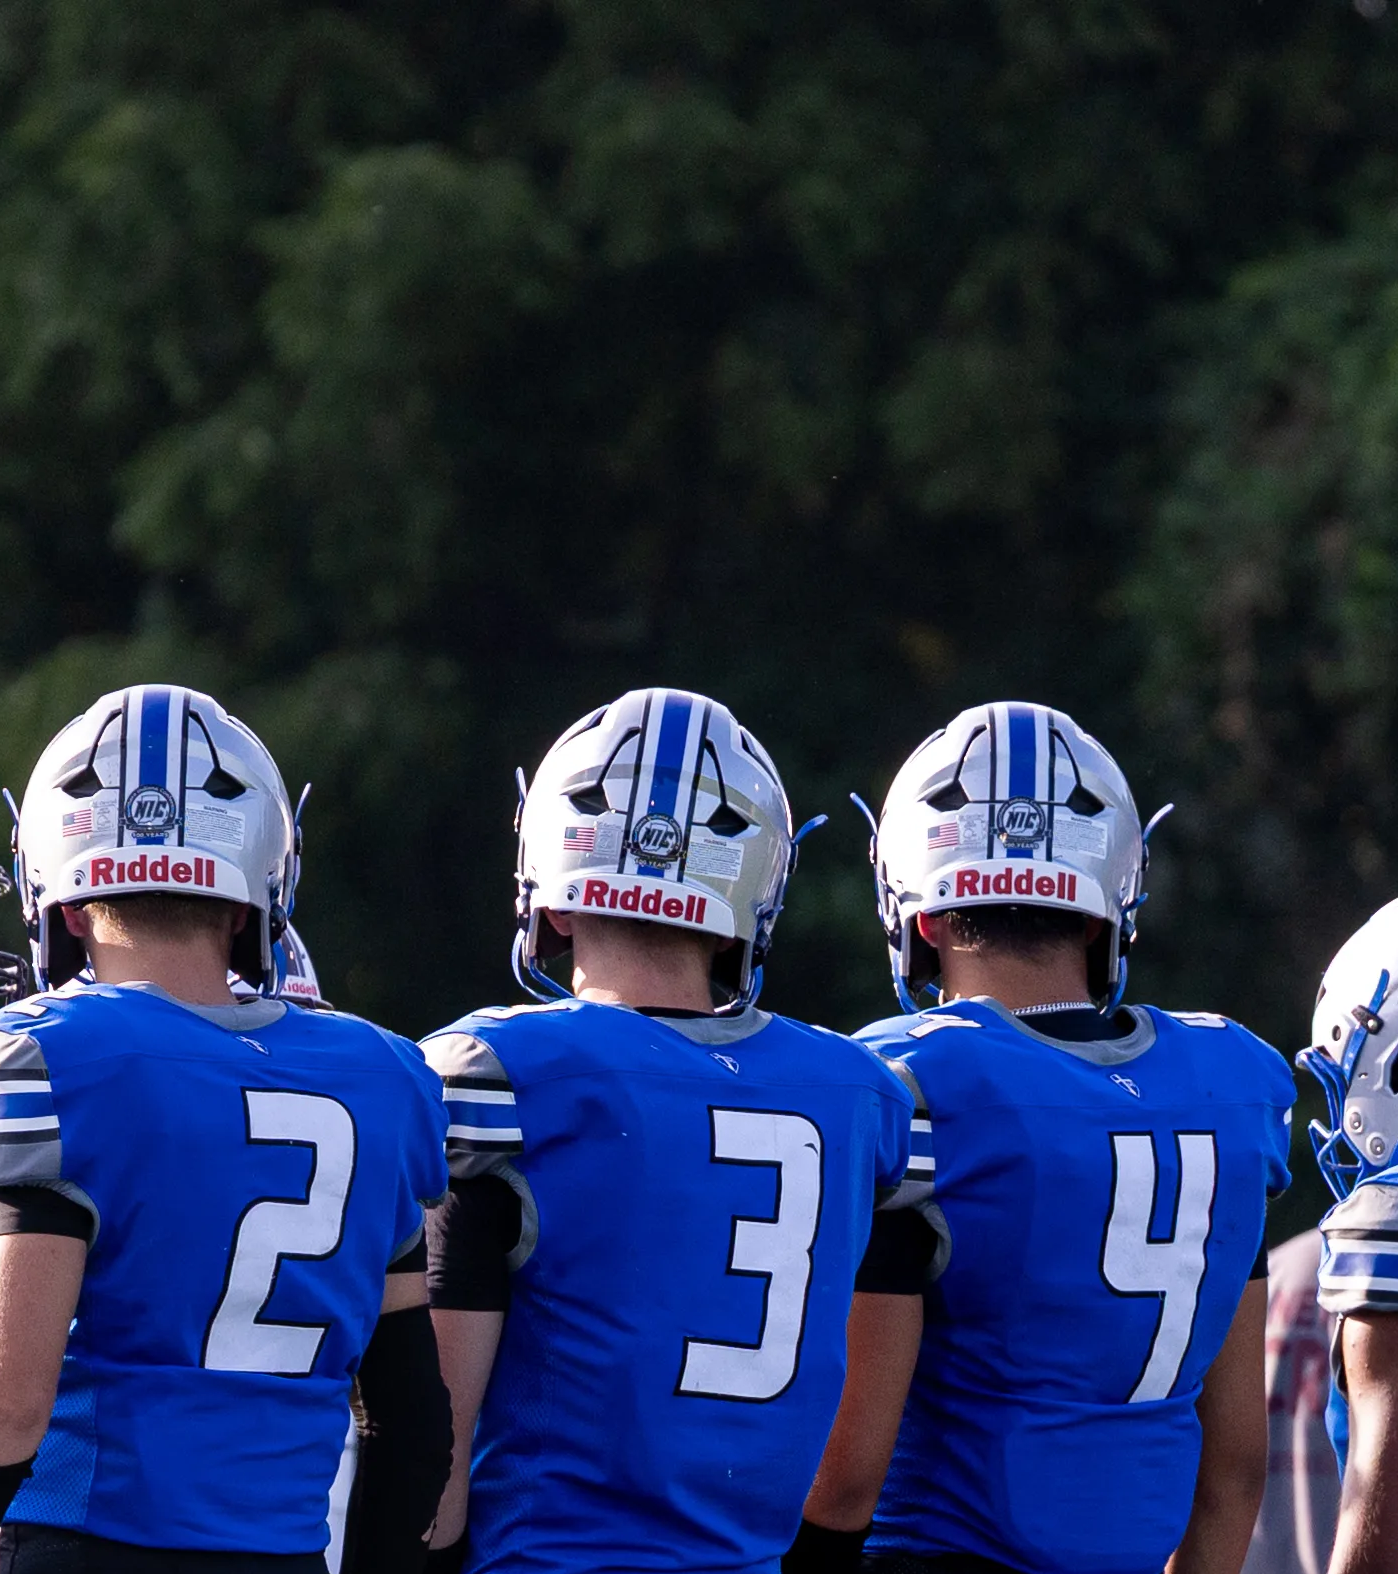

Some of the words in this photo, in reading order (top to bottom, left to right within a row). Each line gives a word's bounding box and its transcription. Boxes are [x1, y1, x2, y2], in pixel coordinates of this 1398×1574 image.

[134, 800, 167, 818] NIC
[1006, 811, 1038, 829] NIC
[641, 826, 675, 848] NIC
[90, 854, 215, 888] Riddell
[956, 867, 1076, 902] Riddell
[583, 879, 707, 924] Riddell
[204, 1087, 355, 1376] 2
[674, 1106, 823, 1402] 3
[1100, 1131, 1217, 1404] 4
